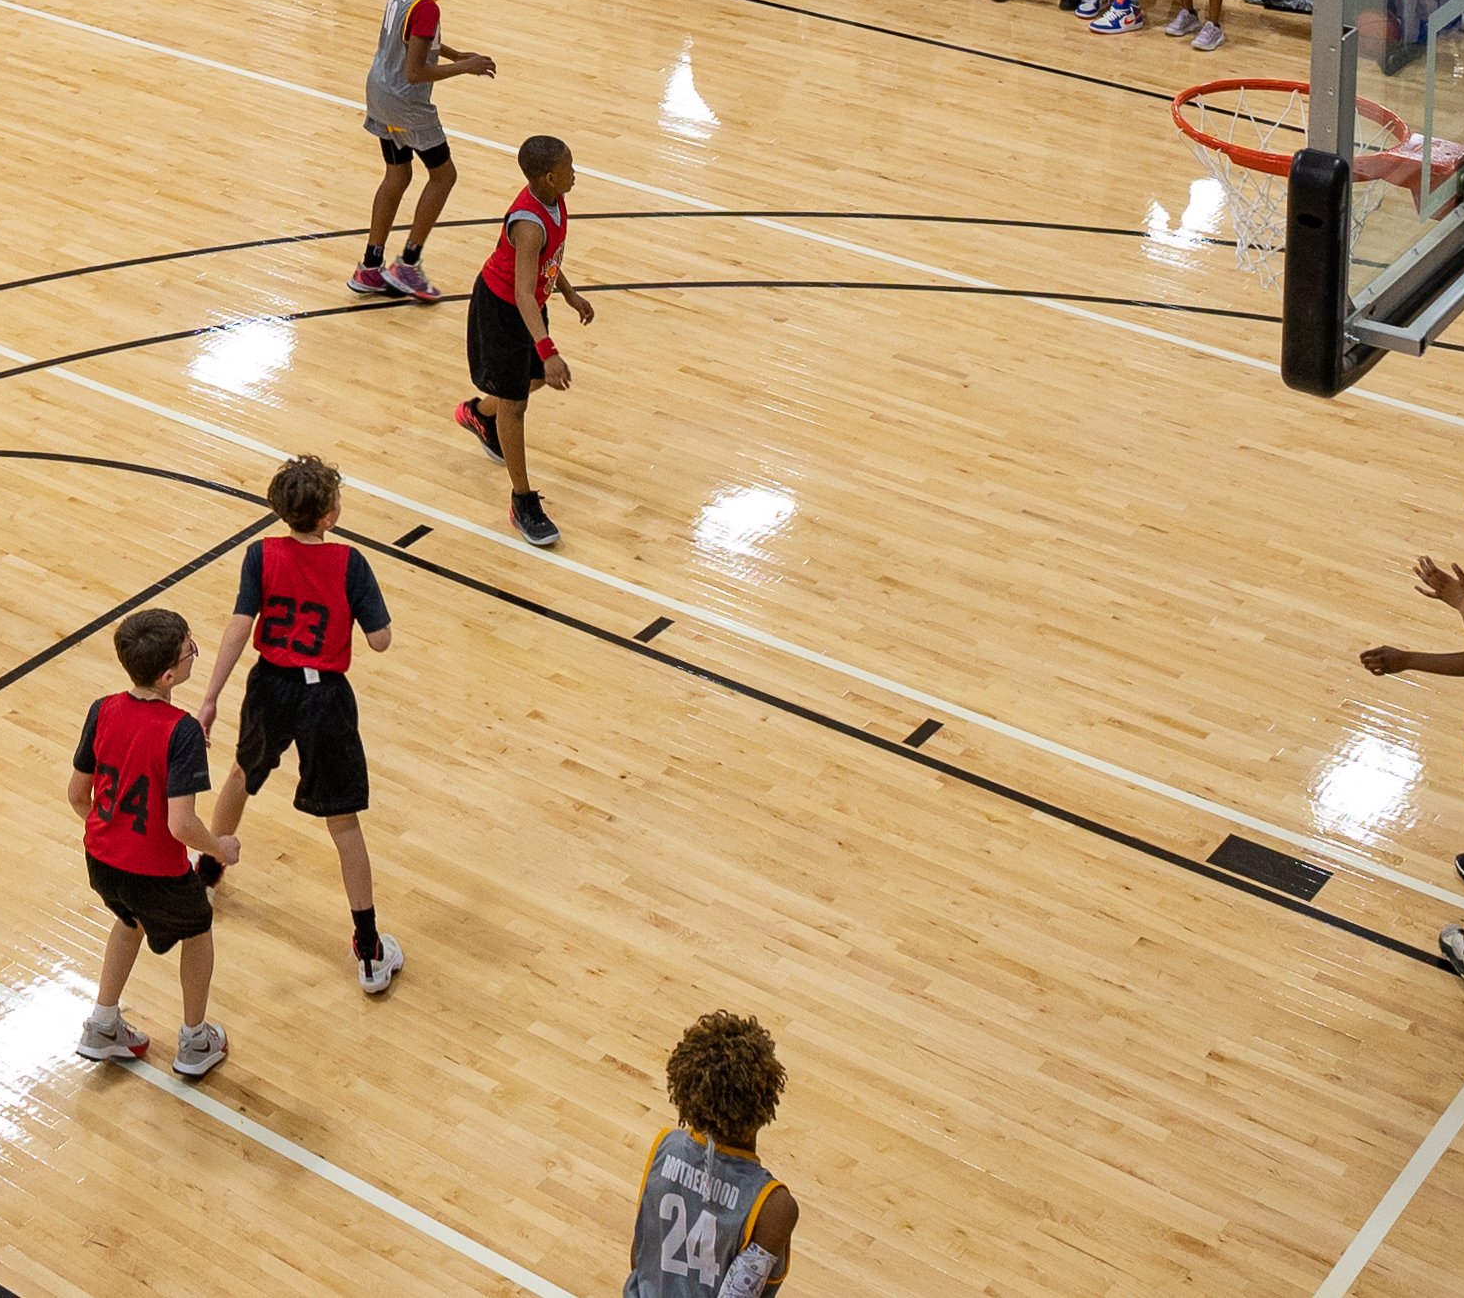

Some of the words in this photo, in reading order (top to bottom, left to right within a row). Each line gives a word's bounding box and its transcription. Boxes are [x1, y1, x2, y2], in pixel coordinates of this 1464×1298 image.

[261, 595, 330, 656] 23
[97, 764, 150, 835] 34
[659, 1193, 720, 1288] 24
